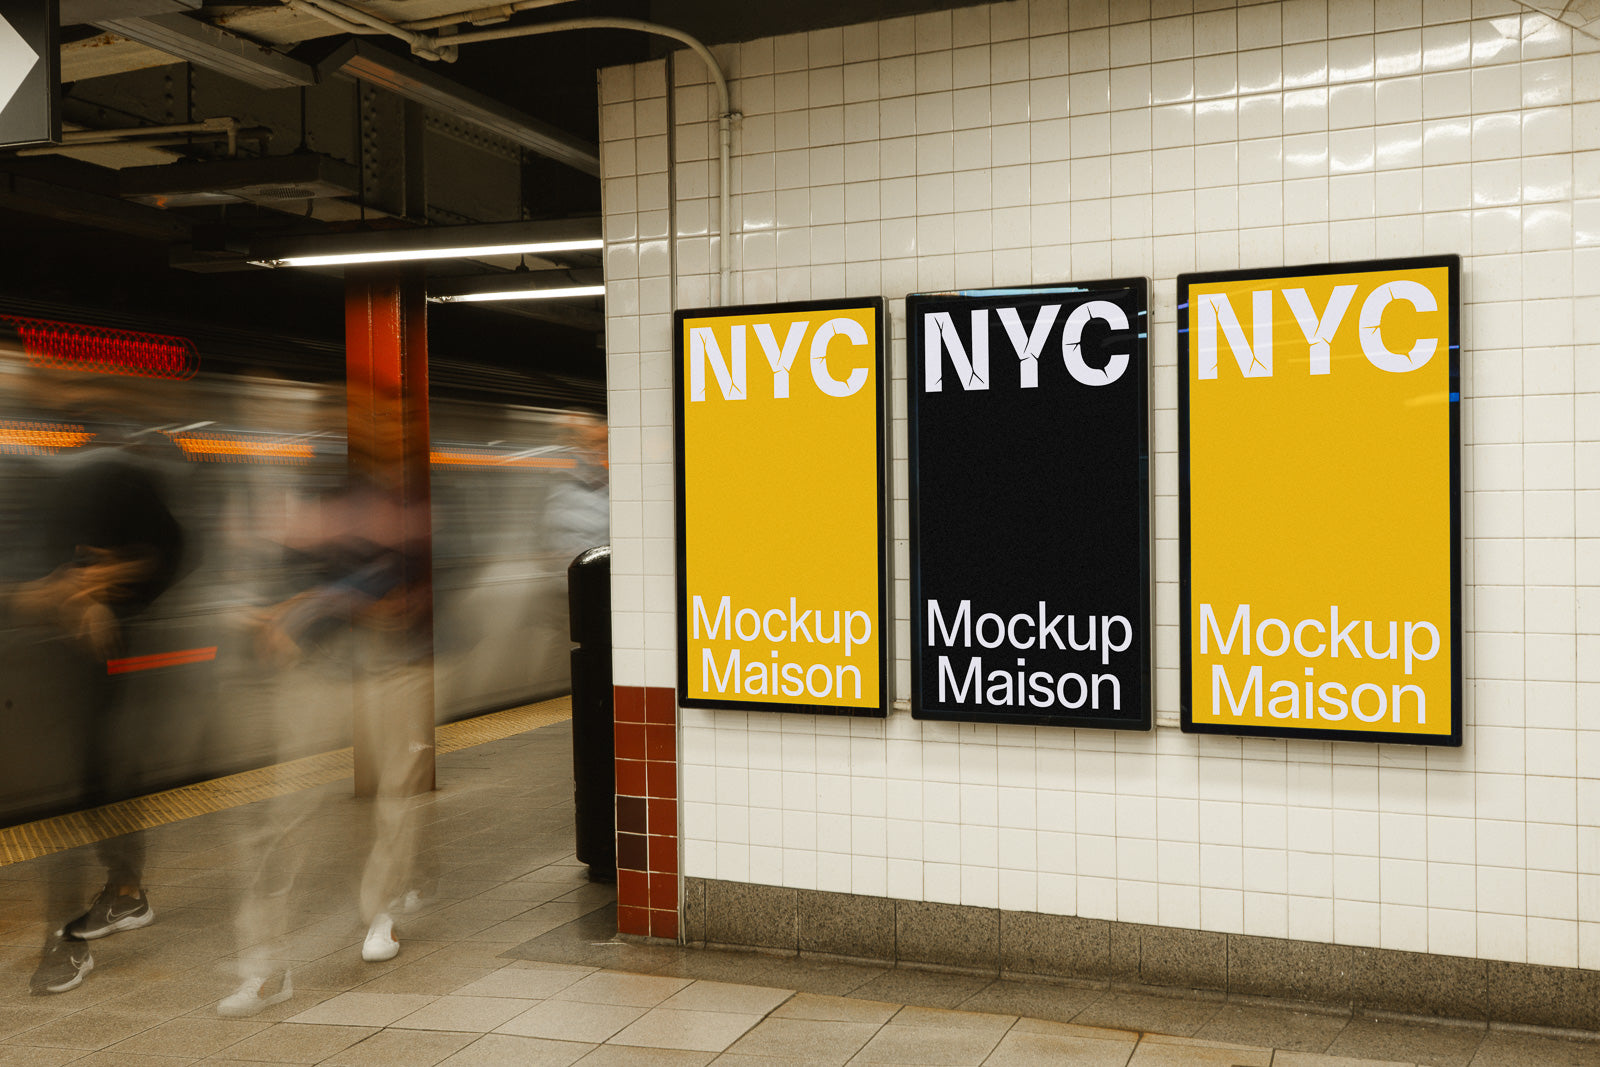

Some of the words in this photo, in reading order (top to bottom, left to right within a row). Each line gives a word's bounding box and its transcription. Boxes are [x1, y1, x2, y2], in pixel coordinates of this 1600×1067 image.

[690, 318, 868, 402] NYC
[925, 301, 1129, 392] NYC
[1198, 281, 1438, 380] NYC
[692, 595, 871, 656] Mockup
[927, 599, 1132, 664] Mockup
[1199, 603, 1440, 674] Mockup
[702, 647, 861, 698] Maison
[938, 655, 1120, 710] Maison
[1211, 664, 1425, 724] Maison
